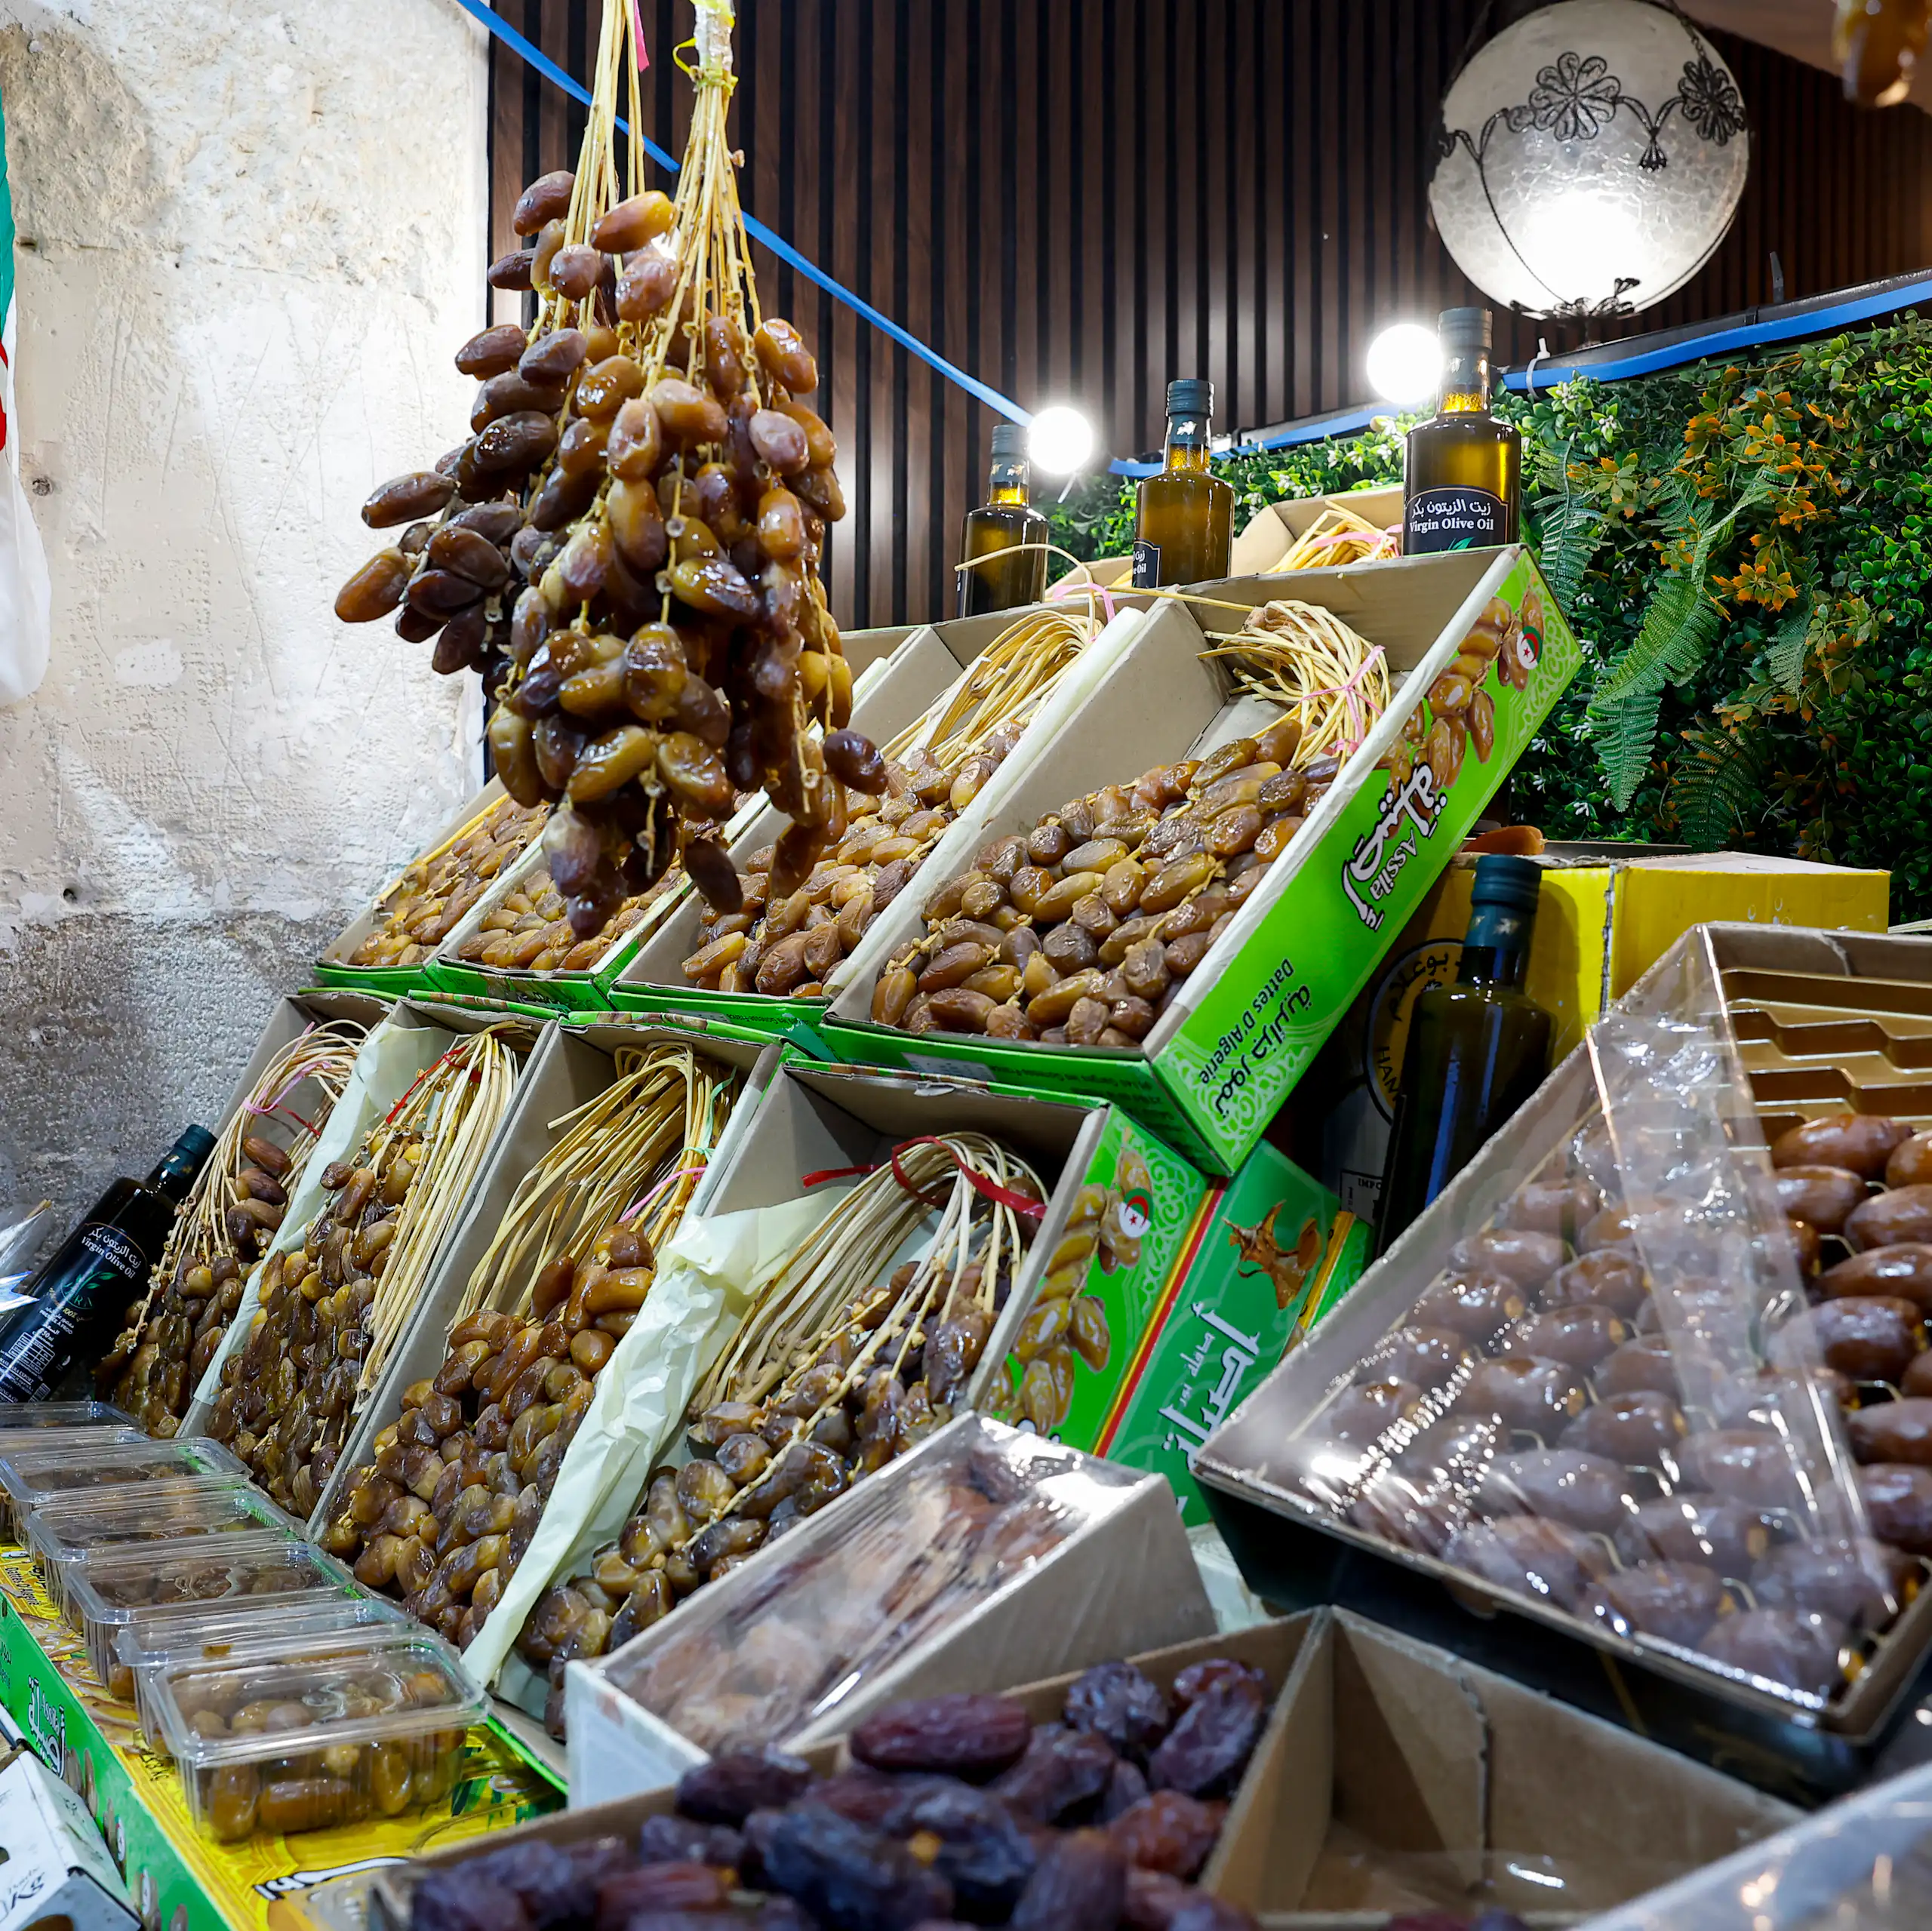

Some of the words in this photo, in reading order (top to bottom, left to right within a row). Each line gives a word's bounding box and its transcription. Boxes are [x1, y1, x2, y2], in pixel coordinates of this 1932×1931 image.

[1411, 497, 1425, 518] بكر
[1426, 498, 1467, 515] الزيتون
[1469, 501, 1491, 516] زيت
[1409, 518, 1439, 533] Virgin
[1441, 518, 1475, 530] Olive
[1476, 518, 1494, 530] Oil
[1137, 563, 1147, 573] Oil
[1369, 827, 1418, 901] Assila
[1252, 958, 1295, 1013] Dattes
[1198, 1010, 1256, 1084] D'Algerie
[1214, 1053, 1252, 1119] تمور
[1251, 984, 1313, 1060] جزائرية
[88, 1226, 105, 1241] بكر
[103, 1234, 130, 1258] الزيتون
[81, 1236, 105, 1255] Virgin
[105, 1252, 126, 1271] Olive
[124, 1268, 136, 1279] Oil
[128, 1253, 142, 1269] زيت
